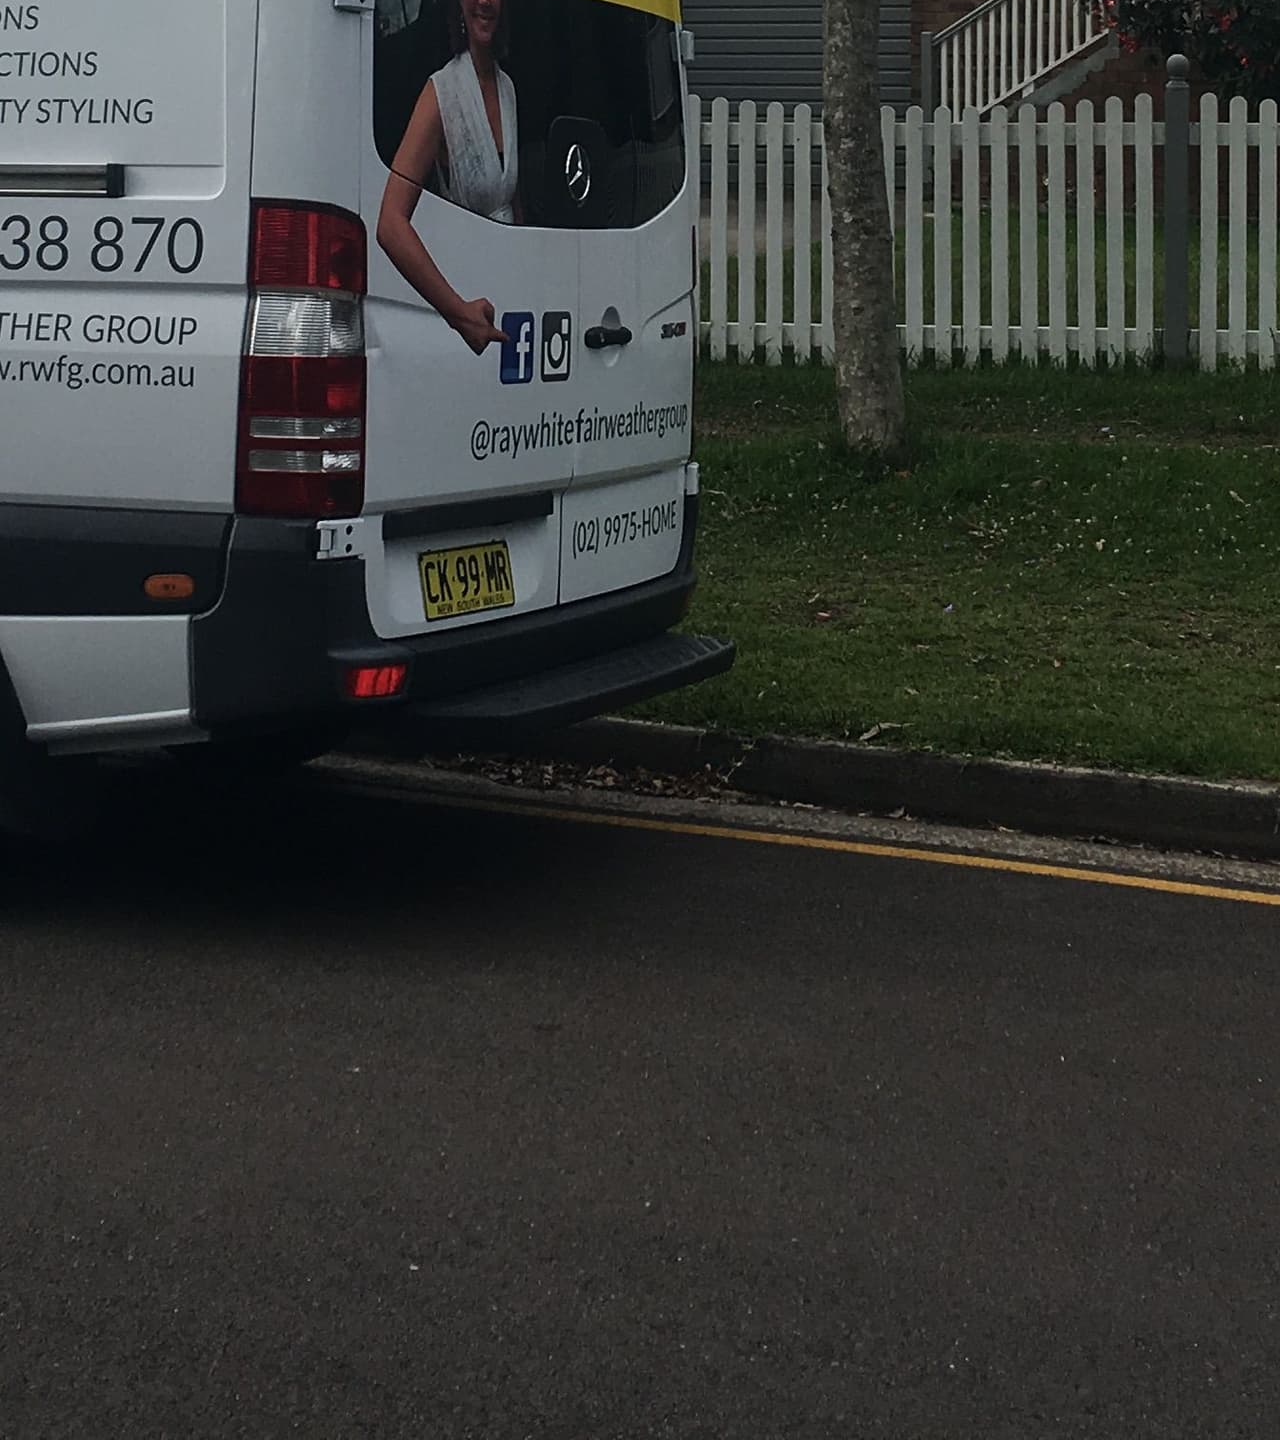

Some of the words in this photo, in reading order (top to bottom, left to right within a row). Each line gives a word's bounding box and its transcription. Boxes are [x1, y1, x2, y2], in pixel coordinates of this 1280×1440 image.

[34, 97, 155, 126] STYLING
[89, 215, 205, 275] 870
[82, 313, 198, 346] GROUP
[470, 401, 689, 461] @raywhitefairweathergroup
[572, 516, 600, 560] (02)
[603, 500, 678, 548] 9975-HOME
